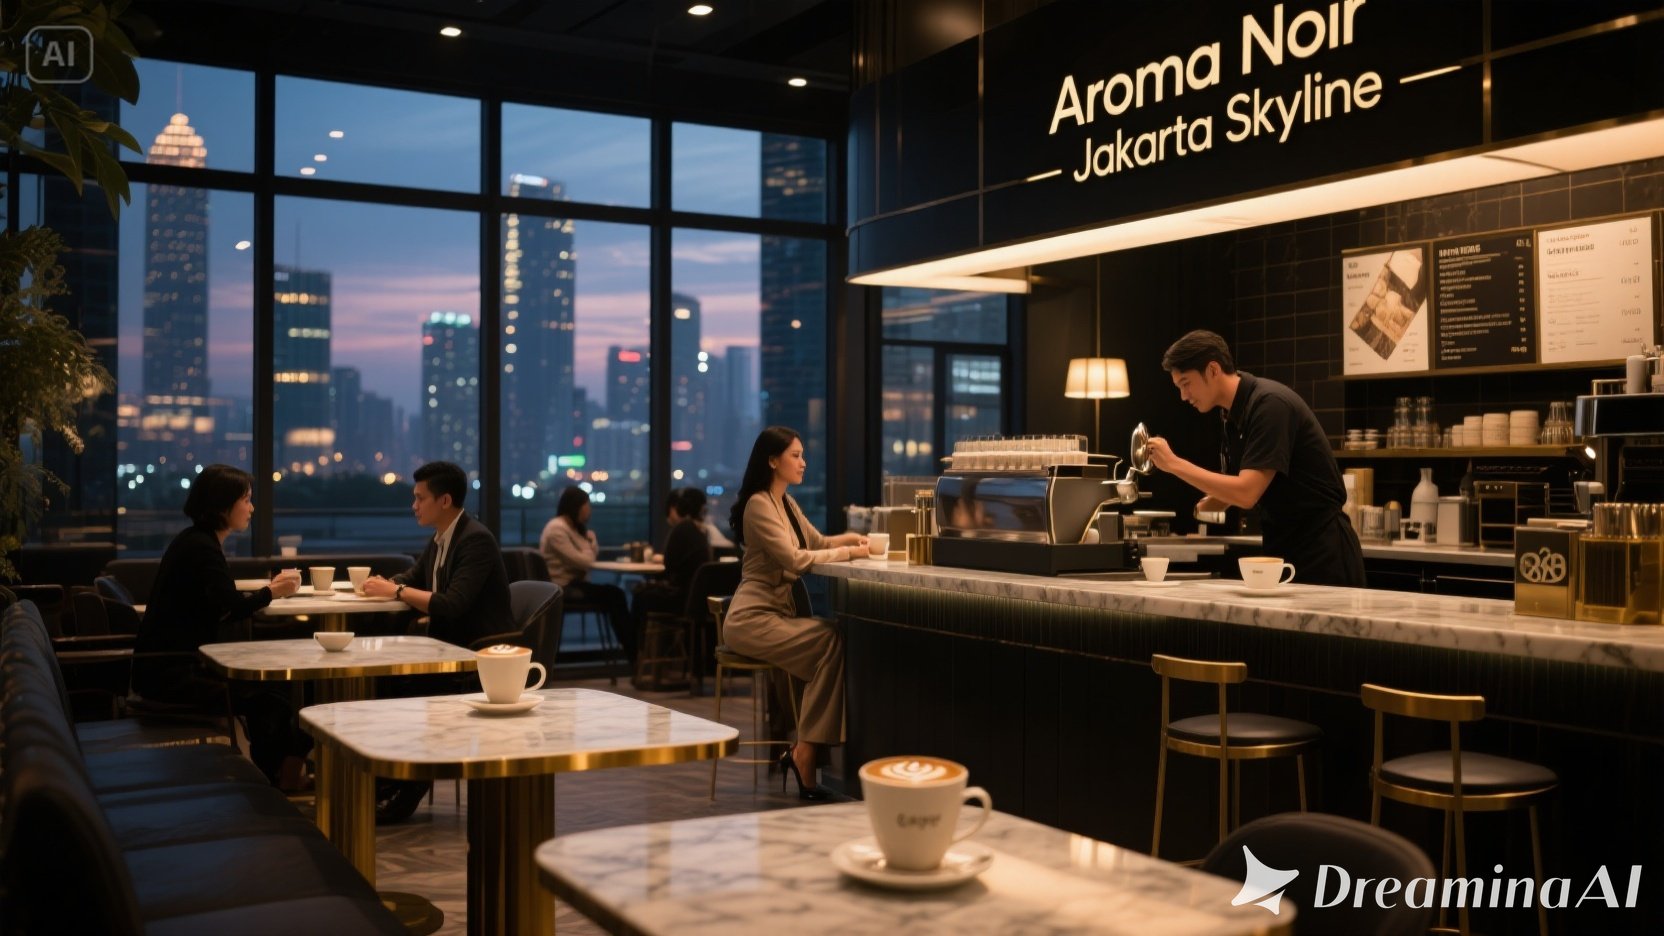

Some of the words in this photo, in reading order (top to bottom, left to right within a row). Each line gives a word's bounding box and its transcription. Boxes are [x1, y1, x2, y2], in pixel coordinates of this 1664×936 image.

[1049, 42, 1221, 135] Aroma
[1242, 0, 1367, 75] Noir
[1073, 116, 1213, 183] Jakarta
[1226, 71, 1383, 143] Skyline
